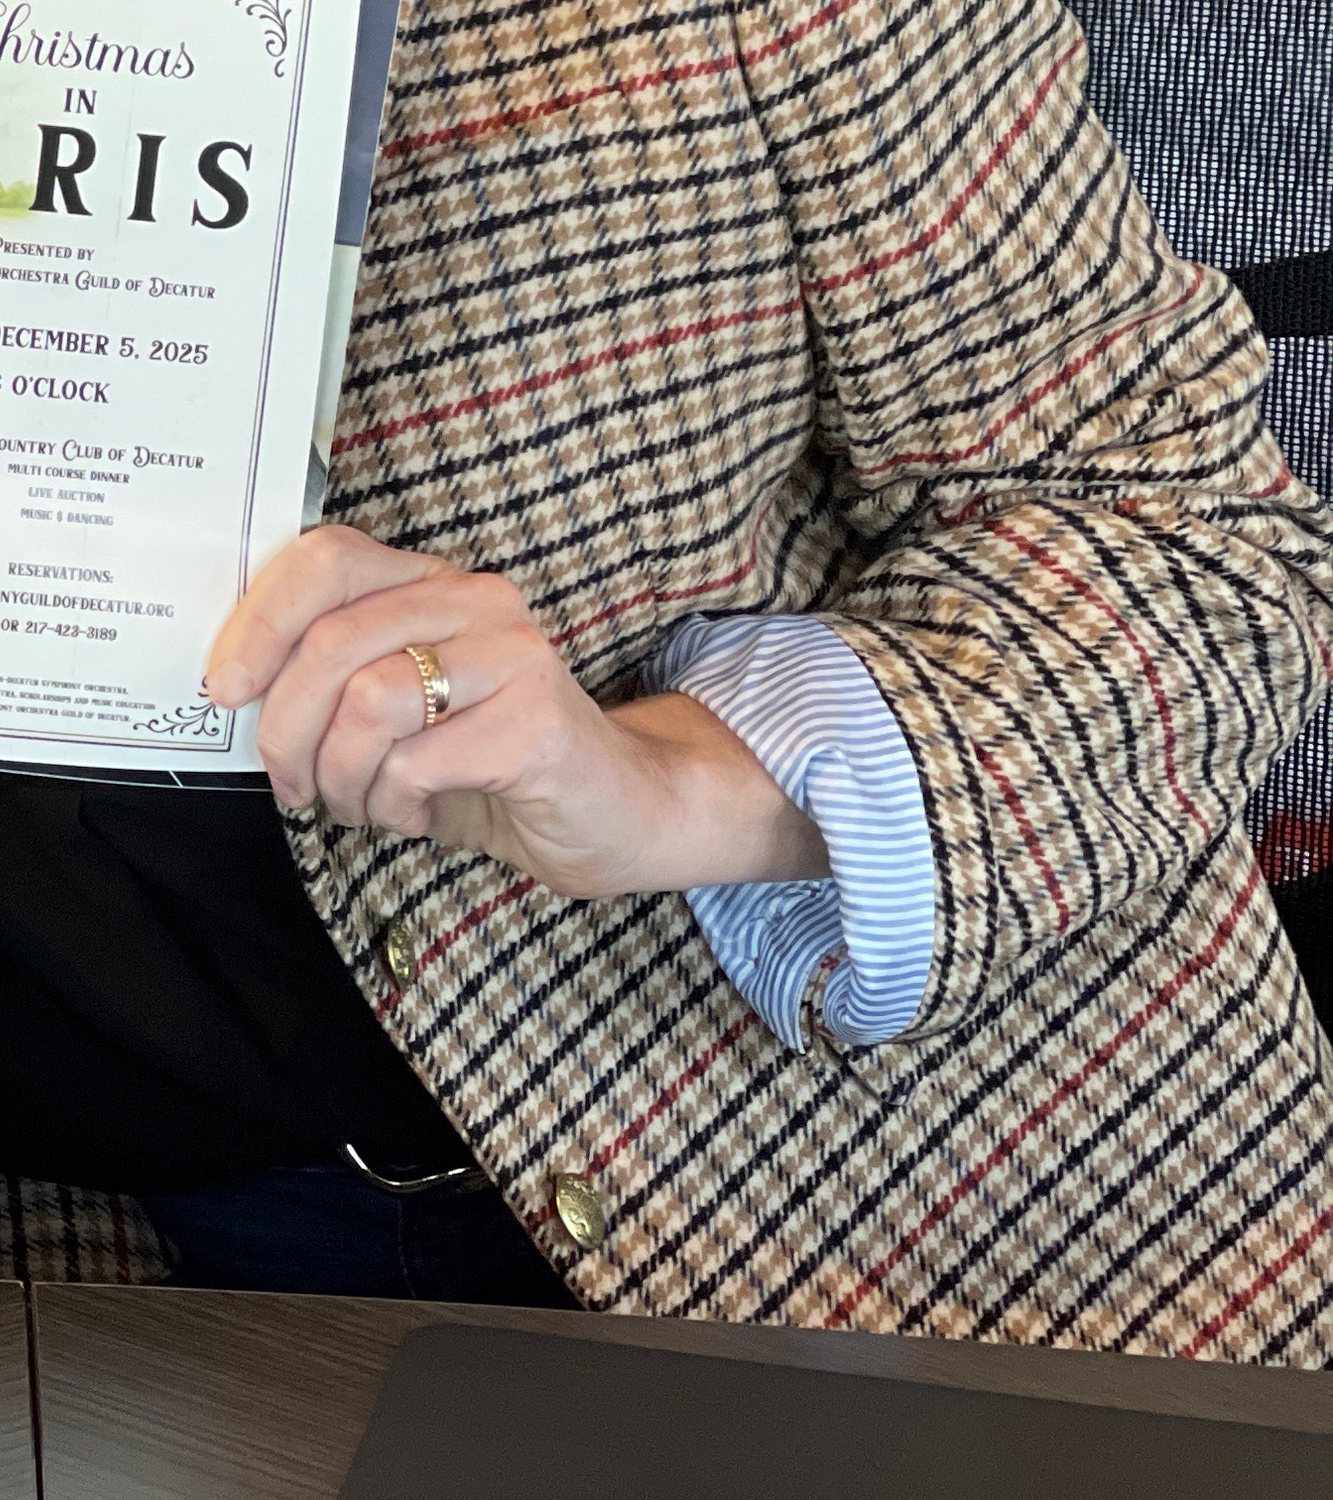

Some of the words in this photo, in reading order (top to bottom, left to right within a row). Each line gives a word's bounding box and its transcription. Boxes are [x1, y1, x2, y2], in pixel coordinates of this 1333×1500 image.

[63, 87, 97, 115] IN
[148, 339, 210, 366] 2025
[11, 375, 112, 404] O'CLOCK
[7, 462, 42, 477] MULTI
[45, 466, 87, 481] COURSE
[90, 469, 131, 485] DINNER
[28, 486, 53, 500] LIVE
[56, 488, 106, 504] AUCTION
[19, 507, 54, 522] MUSIC
[66, 510, 115, 527] DANCING
[7, 561, 115, 584] RESERVATIONS:
[0, 618, 20, 632] OR
[24, 620, 118, 641] 217-423-3189
